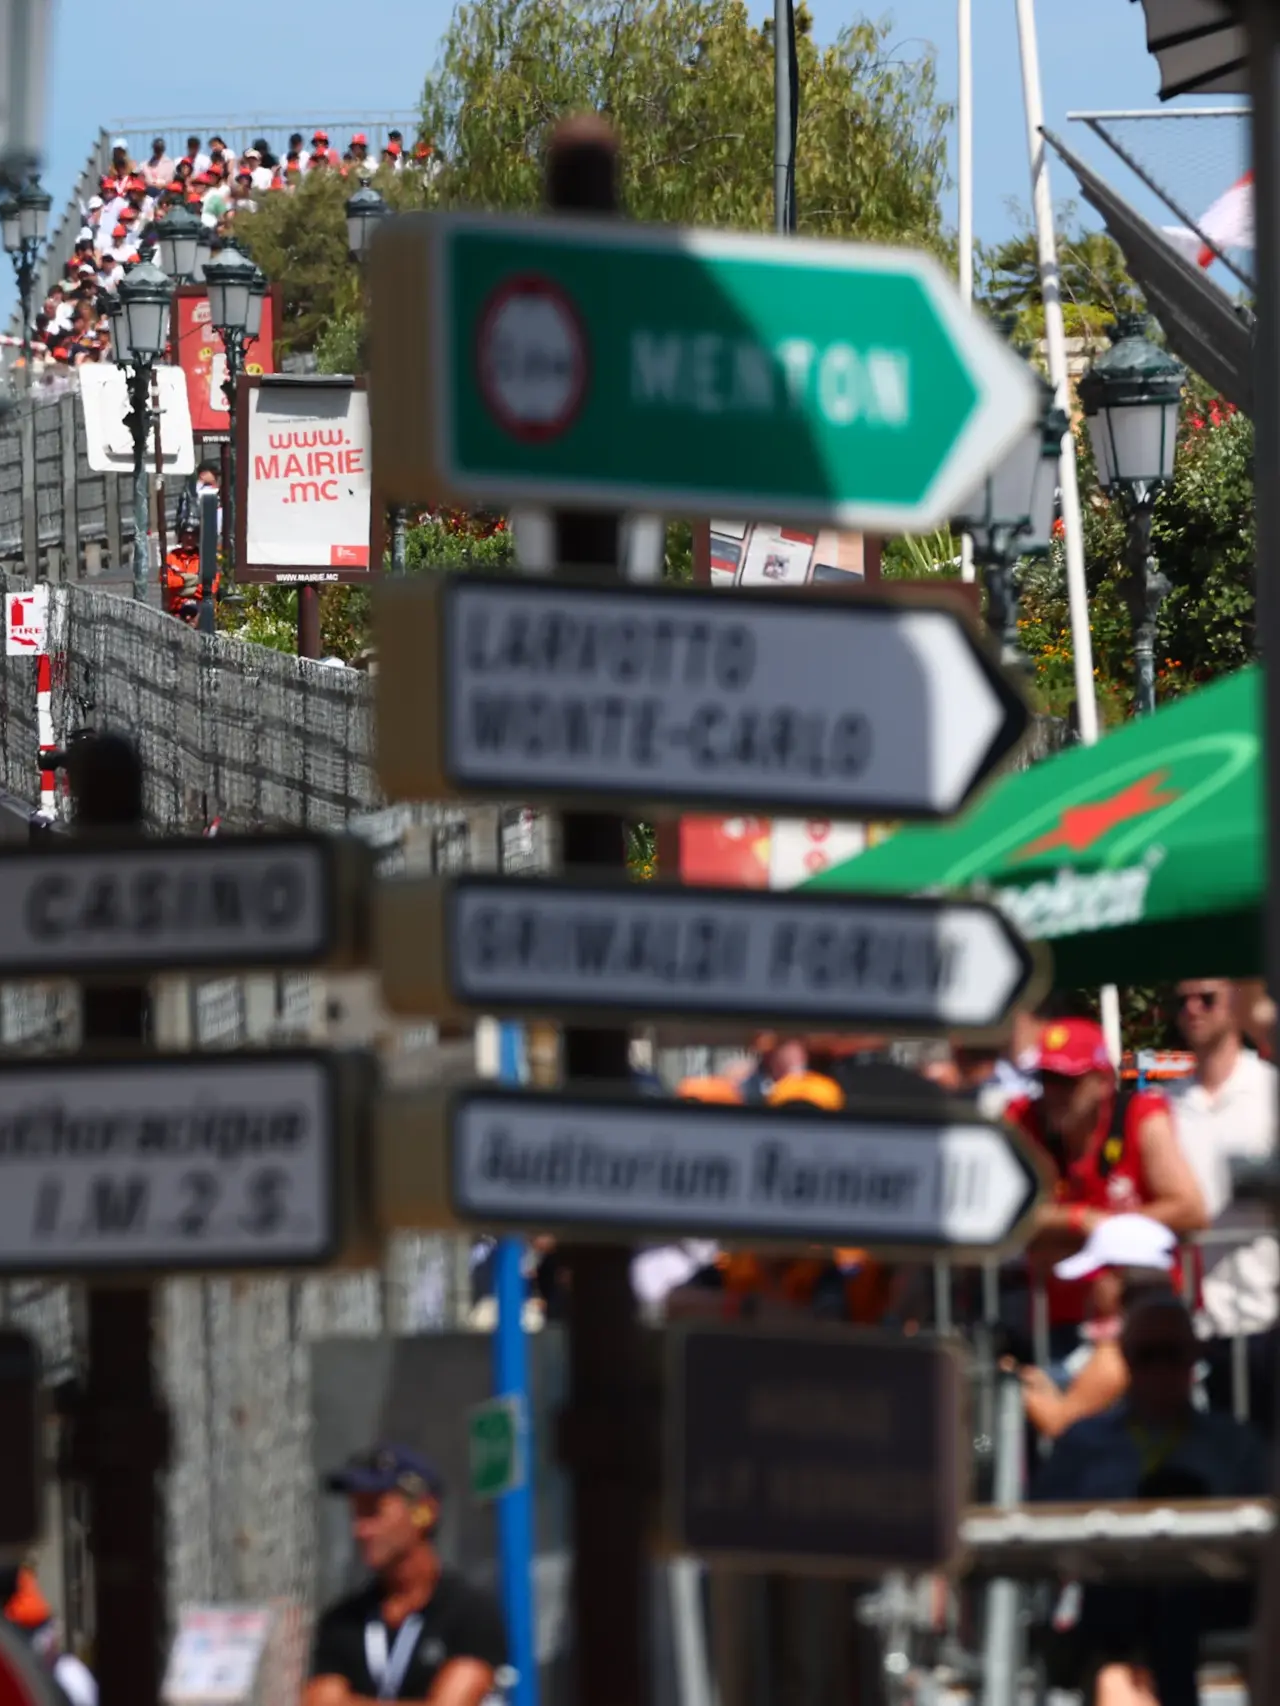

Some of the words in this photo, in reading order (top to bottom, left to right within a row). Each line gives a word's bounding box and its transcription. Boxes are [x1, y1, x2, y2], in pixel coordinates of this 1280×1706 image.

[629, 329, 912, 426] MENTON
[254, 448, 364, 480] MAIRIE
[269, 428, 351, 450] www.
[282, 480, 339, 504] .mc
[276, 572, 339, 582] WWW.MAIRIE.MC
[11, 627, 42, 635] FIRE
[461, 608, 758, 692] LARVOTTO
[466, 687, 875, 781] MONTE-CARLO
[24, 861, 308, 943] CASINO
[472, 907, 750, 990] GRIMALDI
[767, 920, 968, 997] FORUM
[481, 1124, 735, 1196] Auditorium
[750, 1139, 919, 1206] Rainier
